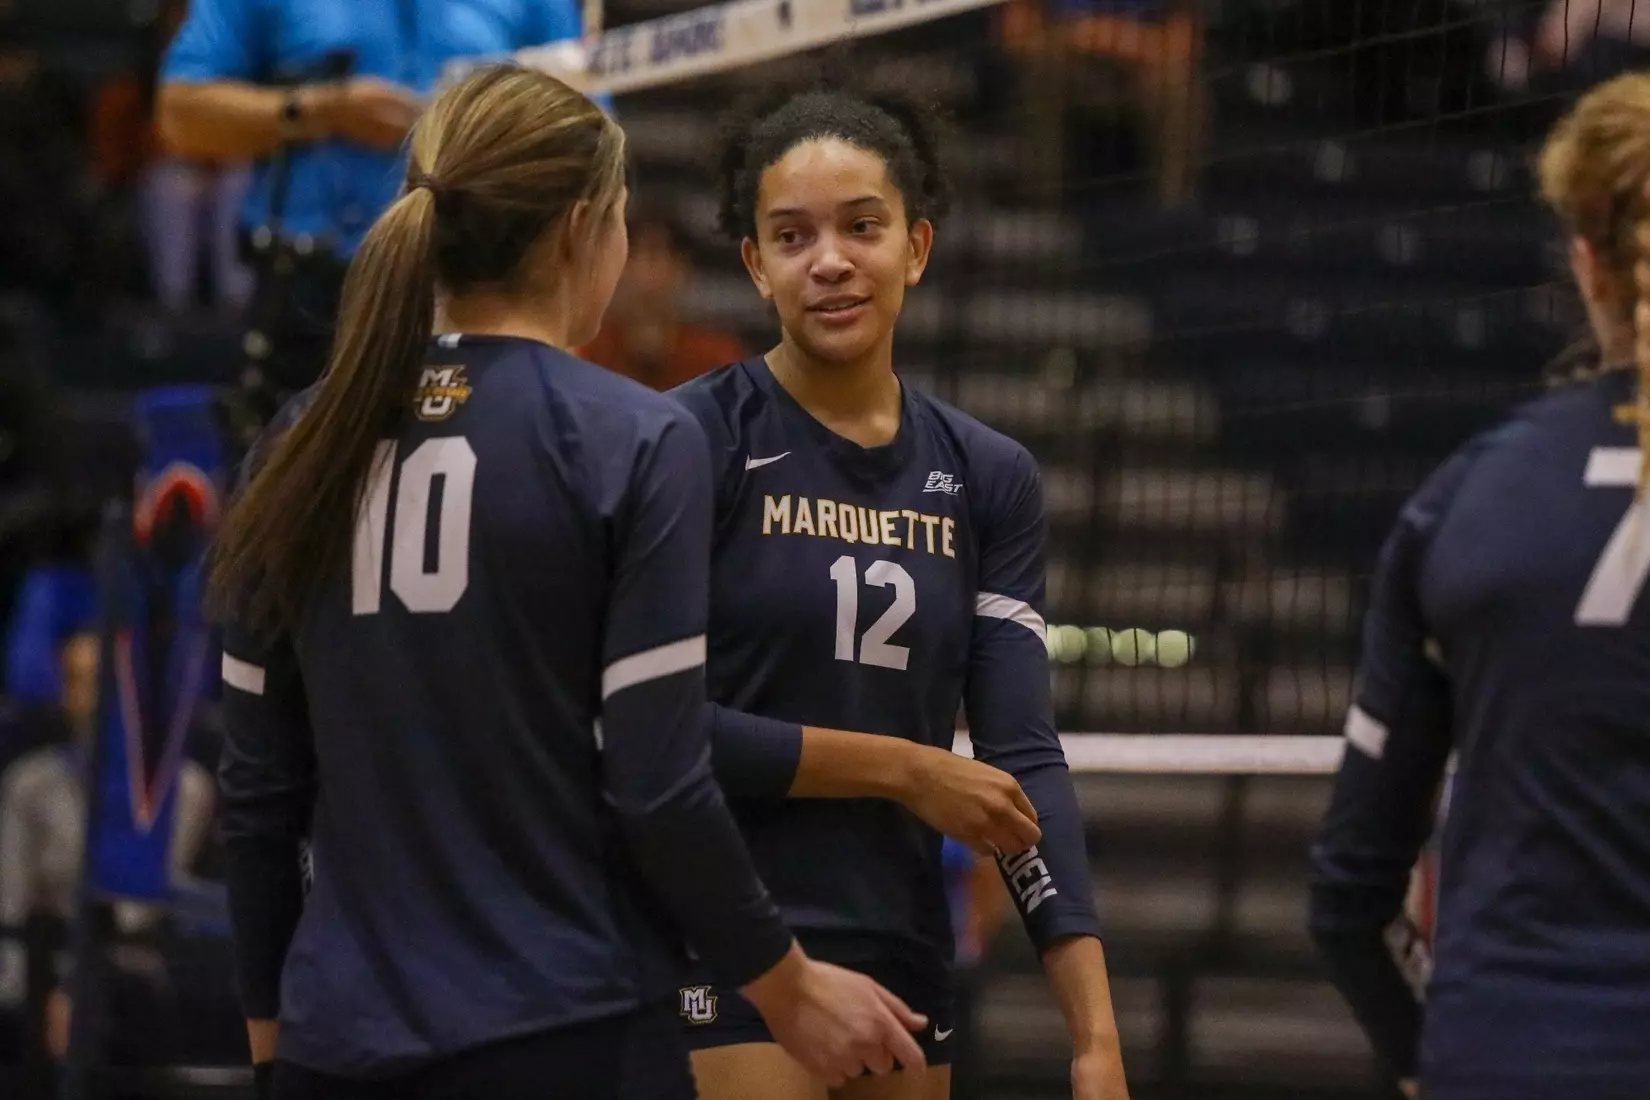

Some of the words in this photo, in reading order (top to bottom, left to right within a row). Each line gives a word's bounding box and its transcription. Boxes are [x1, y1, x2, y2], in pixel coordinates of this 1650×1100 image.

[924, 480, 964, 493] EAST
[928, 470, 954, 484] BIG
[352, 436, 478, 615] 10
[762, 494, 956, 559] MARQUETTE
[1573, 447, 1650, 627] 7
[829, 555, 917, 671] 12
[681, 987, 717, 1022] MU
